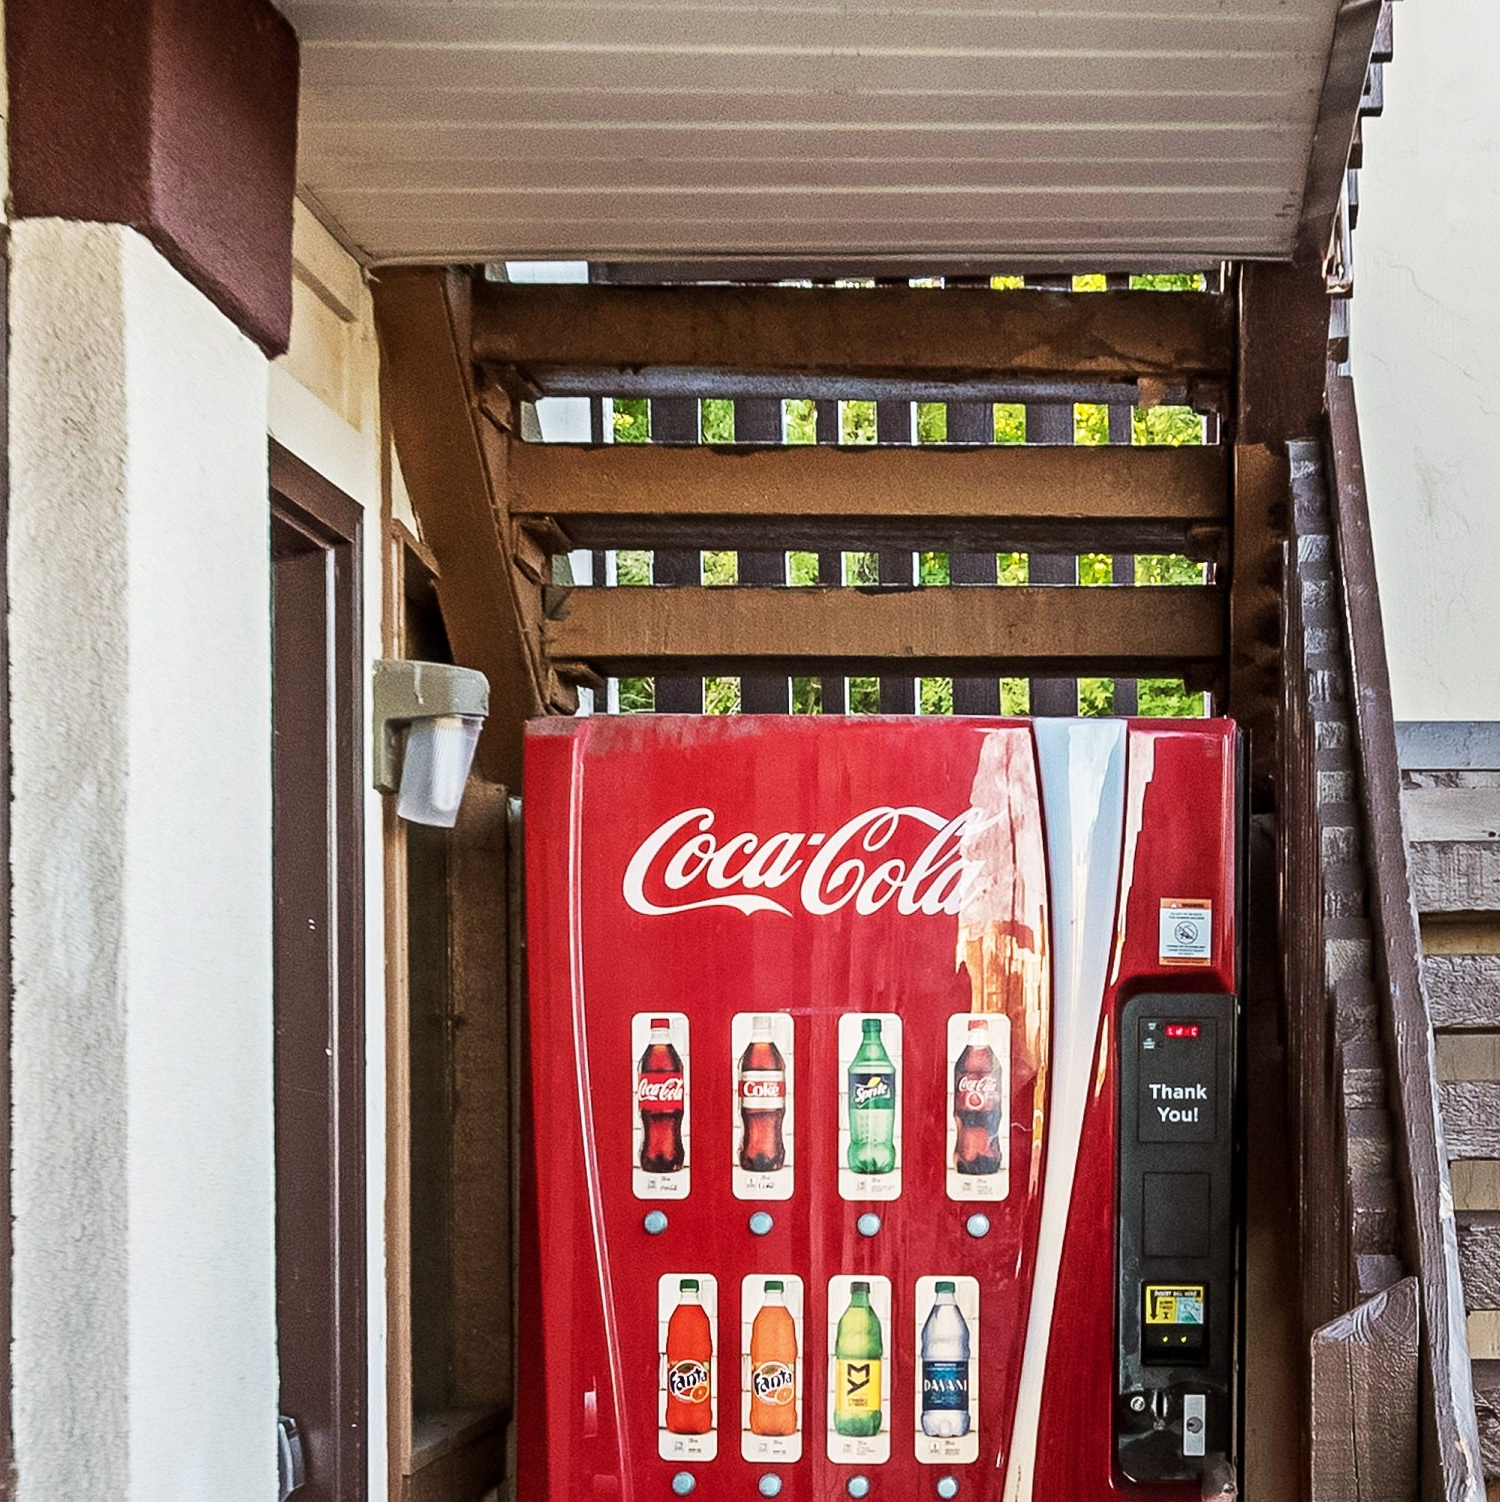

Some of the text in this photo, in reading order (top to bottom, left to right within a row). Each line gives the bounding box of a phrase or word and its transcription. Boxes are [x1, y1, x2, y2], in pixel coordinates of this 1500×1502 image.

[622, 806, 1010, 918] Coca-Cola
[743, 1081, 781, 1097] Coke
[854, 1082, 889, 1104] Sprite
[1148, 1083, 1208, 1100] Thank
[1157, 1106, 1199, 1123] You!
[923, 1379, 967, 1392] DASANI
